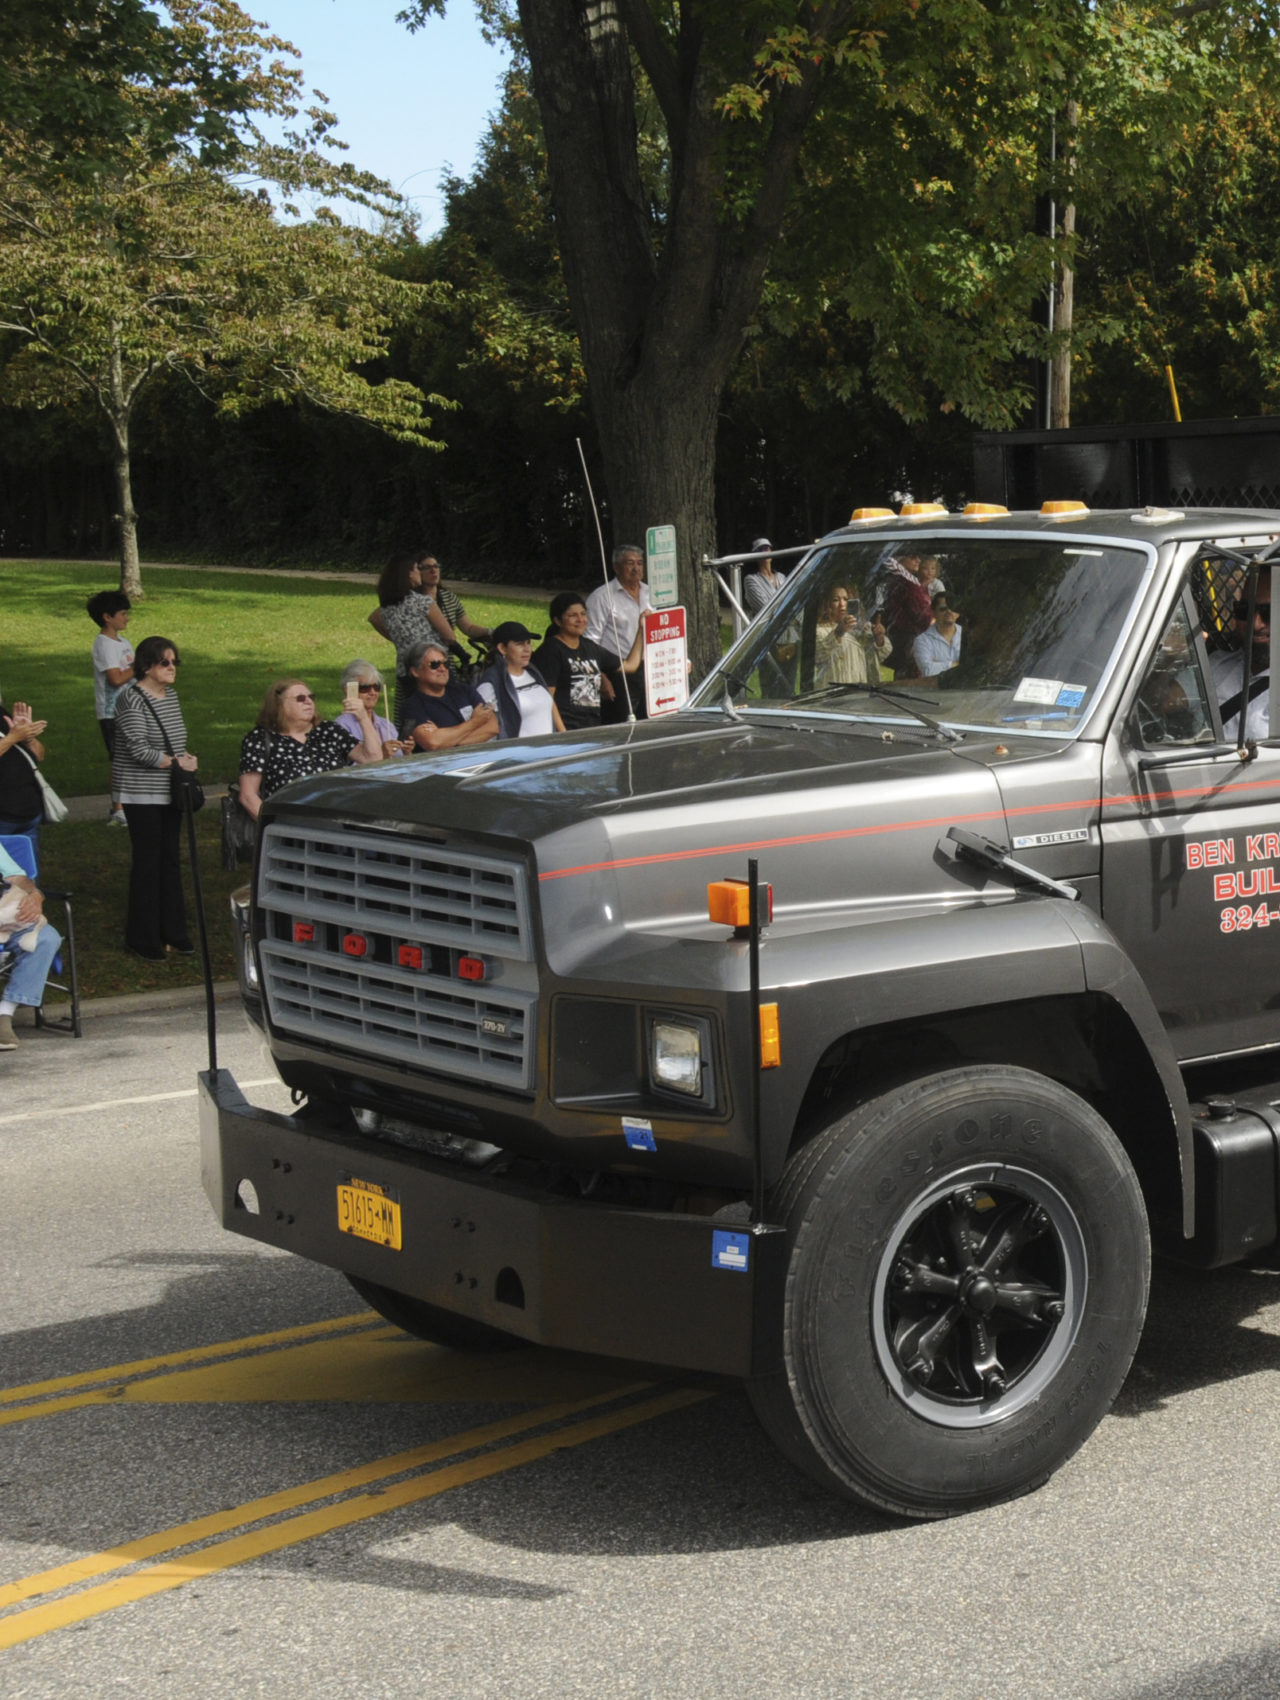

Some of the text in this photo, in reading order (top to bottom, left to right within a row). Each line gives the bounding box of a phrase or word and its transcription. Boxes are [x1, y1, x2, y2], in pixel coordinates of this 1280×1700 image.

[659, 613, 669, 626] NO
[650, 626, 680, 642] STOPPING
[1040, 831, 1085, 843] DIESEL
[1185, 836, 1237, 871] BEN
[292, 921, 485, 981] FORD
